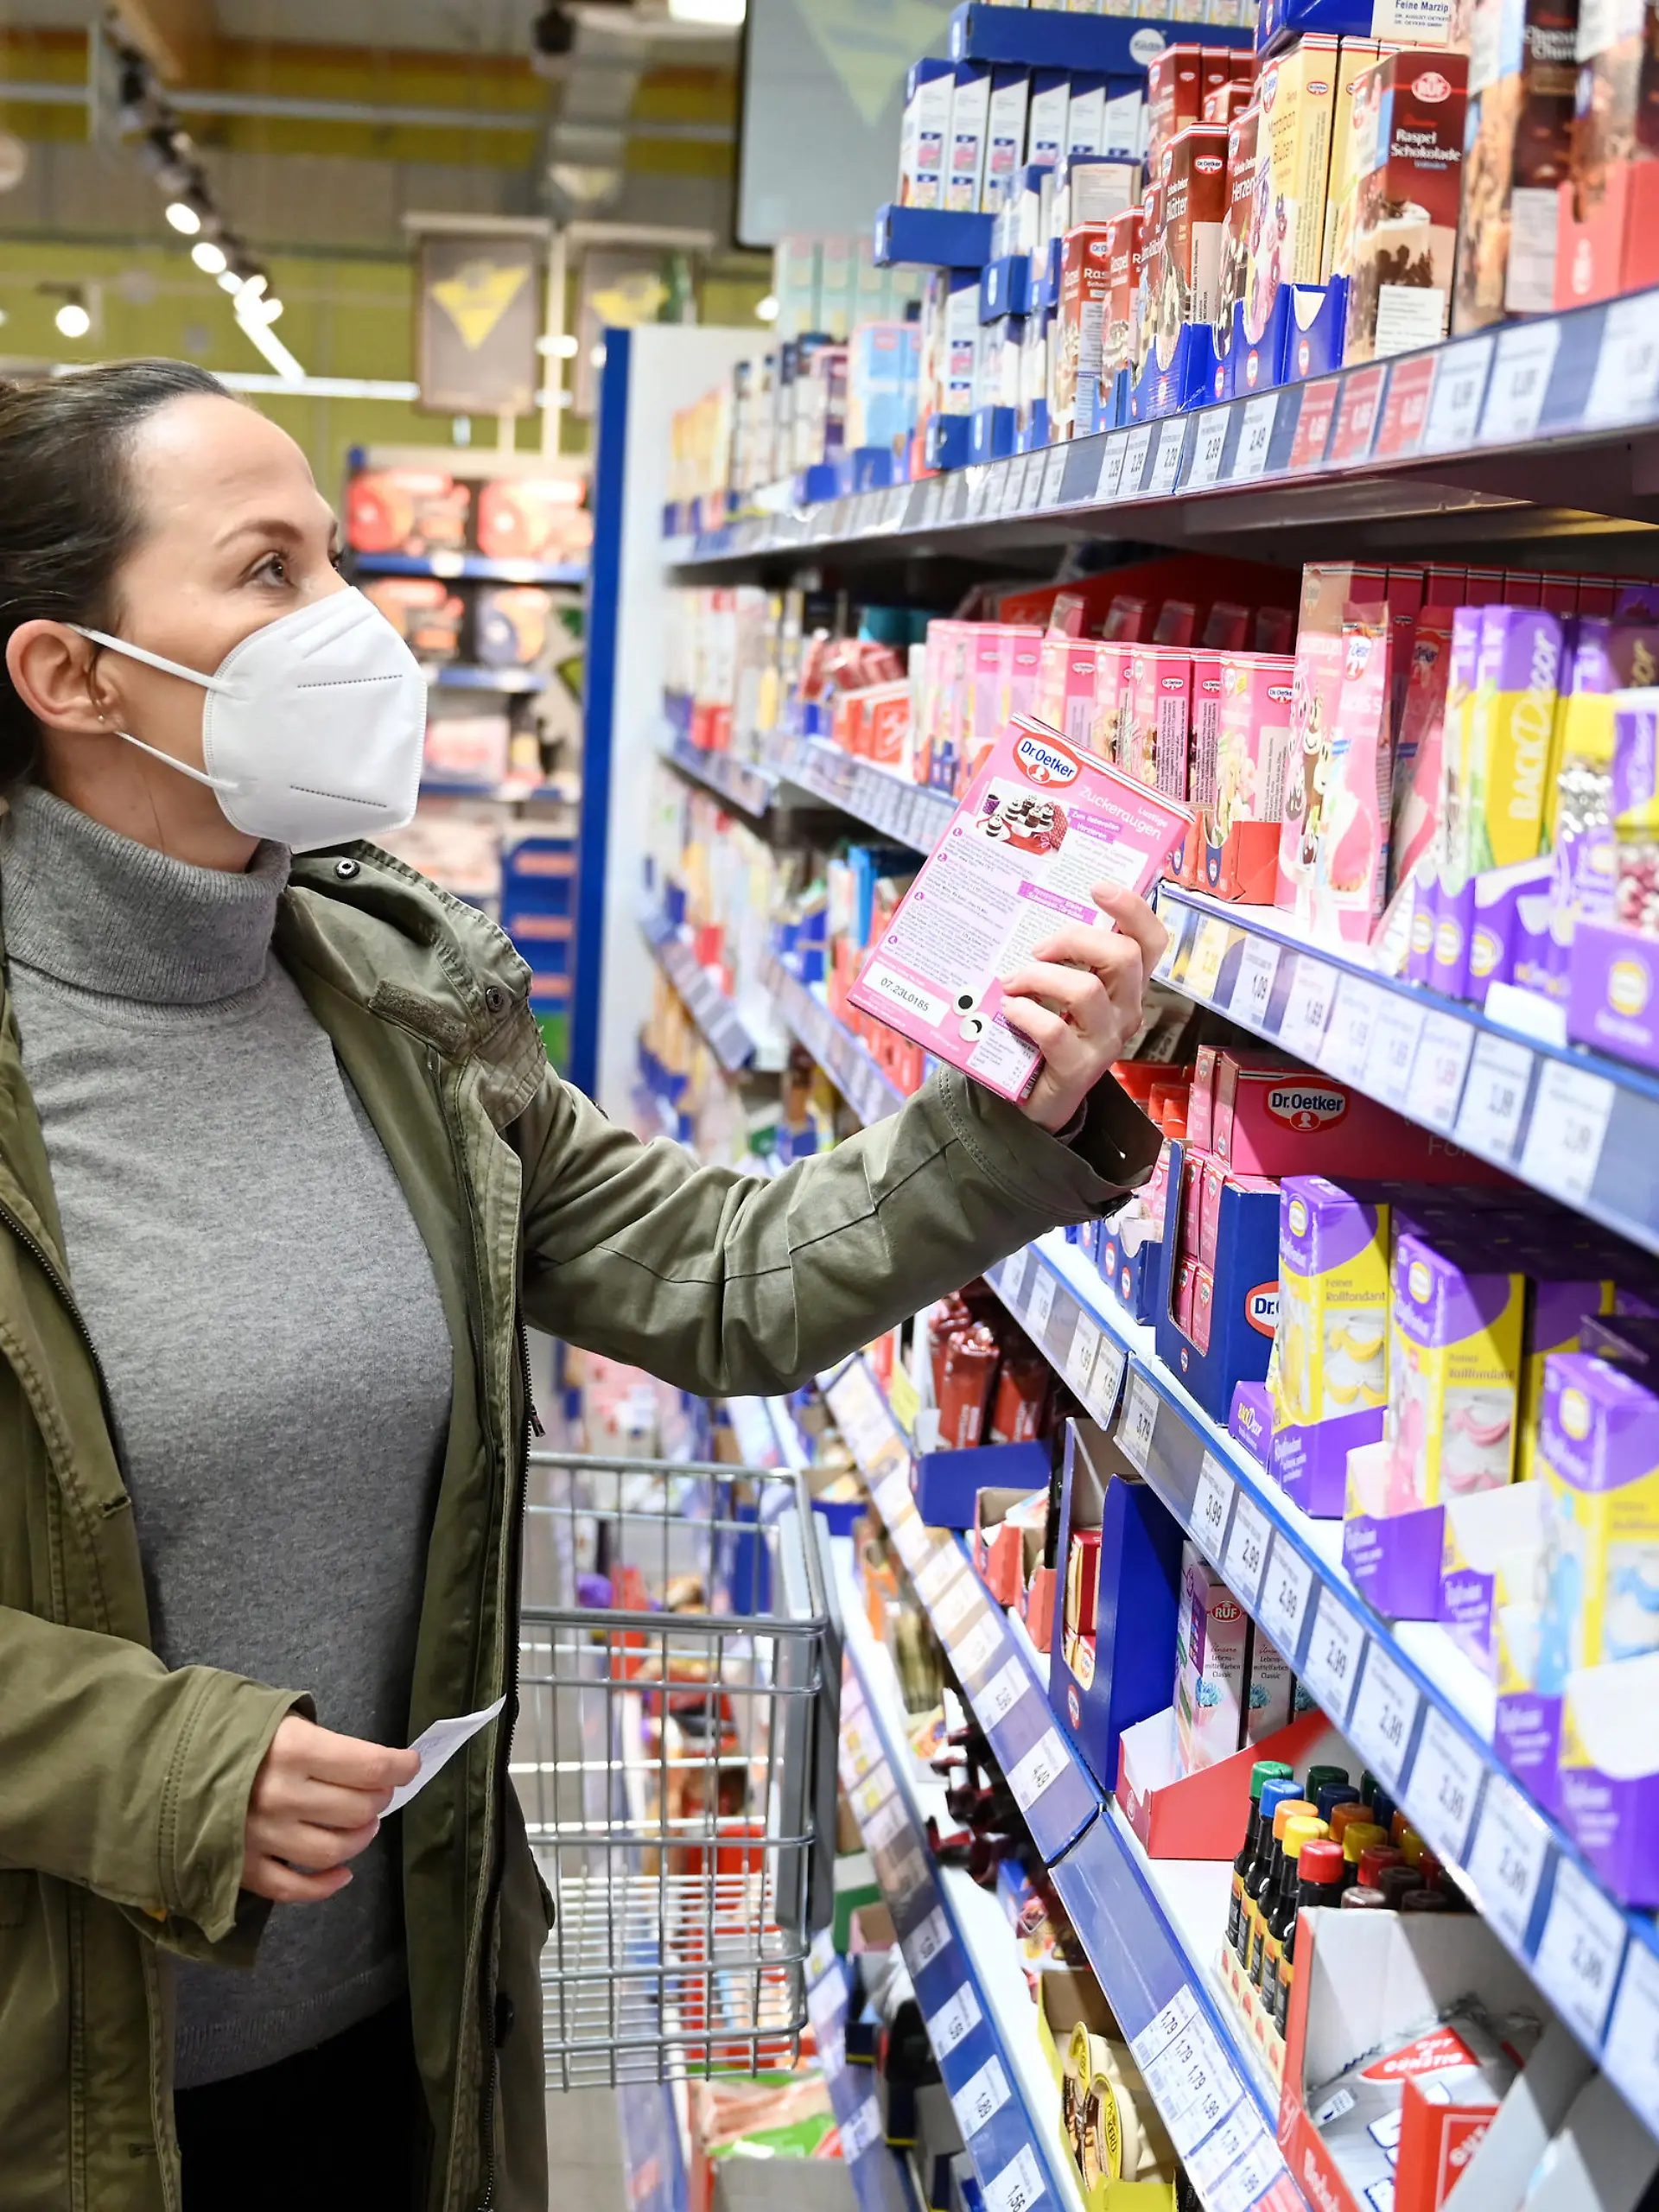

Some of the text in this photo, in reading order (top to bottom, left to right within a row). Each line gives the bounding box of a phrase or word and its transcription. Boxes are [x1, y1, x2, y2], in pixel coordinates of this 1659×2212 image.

[1395, 0, 1418, 10] Feine
[1391, 143, 1462, 162] Schokolade
[1079, 785, 1162, 832] Zuckeraugen
[1137, 806, 1169, 829] Lustige
[880, 977, 930, 1012] 07.23L0185
[1326, 1292, 1385, 1302] Rollfondant
[1136, 1412, 1151, 1442] 3,79
[1206, 1494, 1223, 1528] 3,99
[1243, 1539, 1260, 1573] 2,99
[1160, 2010, 1179, 2035] 1,79
[1175, 2038, 1193, 2063] 1,79
[1384, 2052, 1464, 2073] GÜNSTIG
[1187, 2064, 1206, 2090] 1,79
[976, 2091, 992, 2119] 1,89
